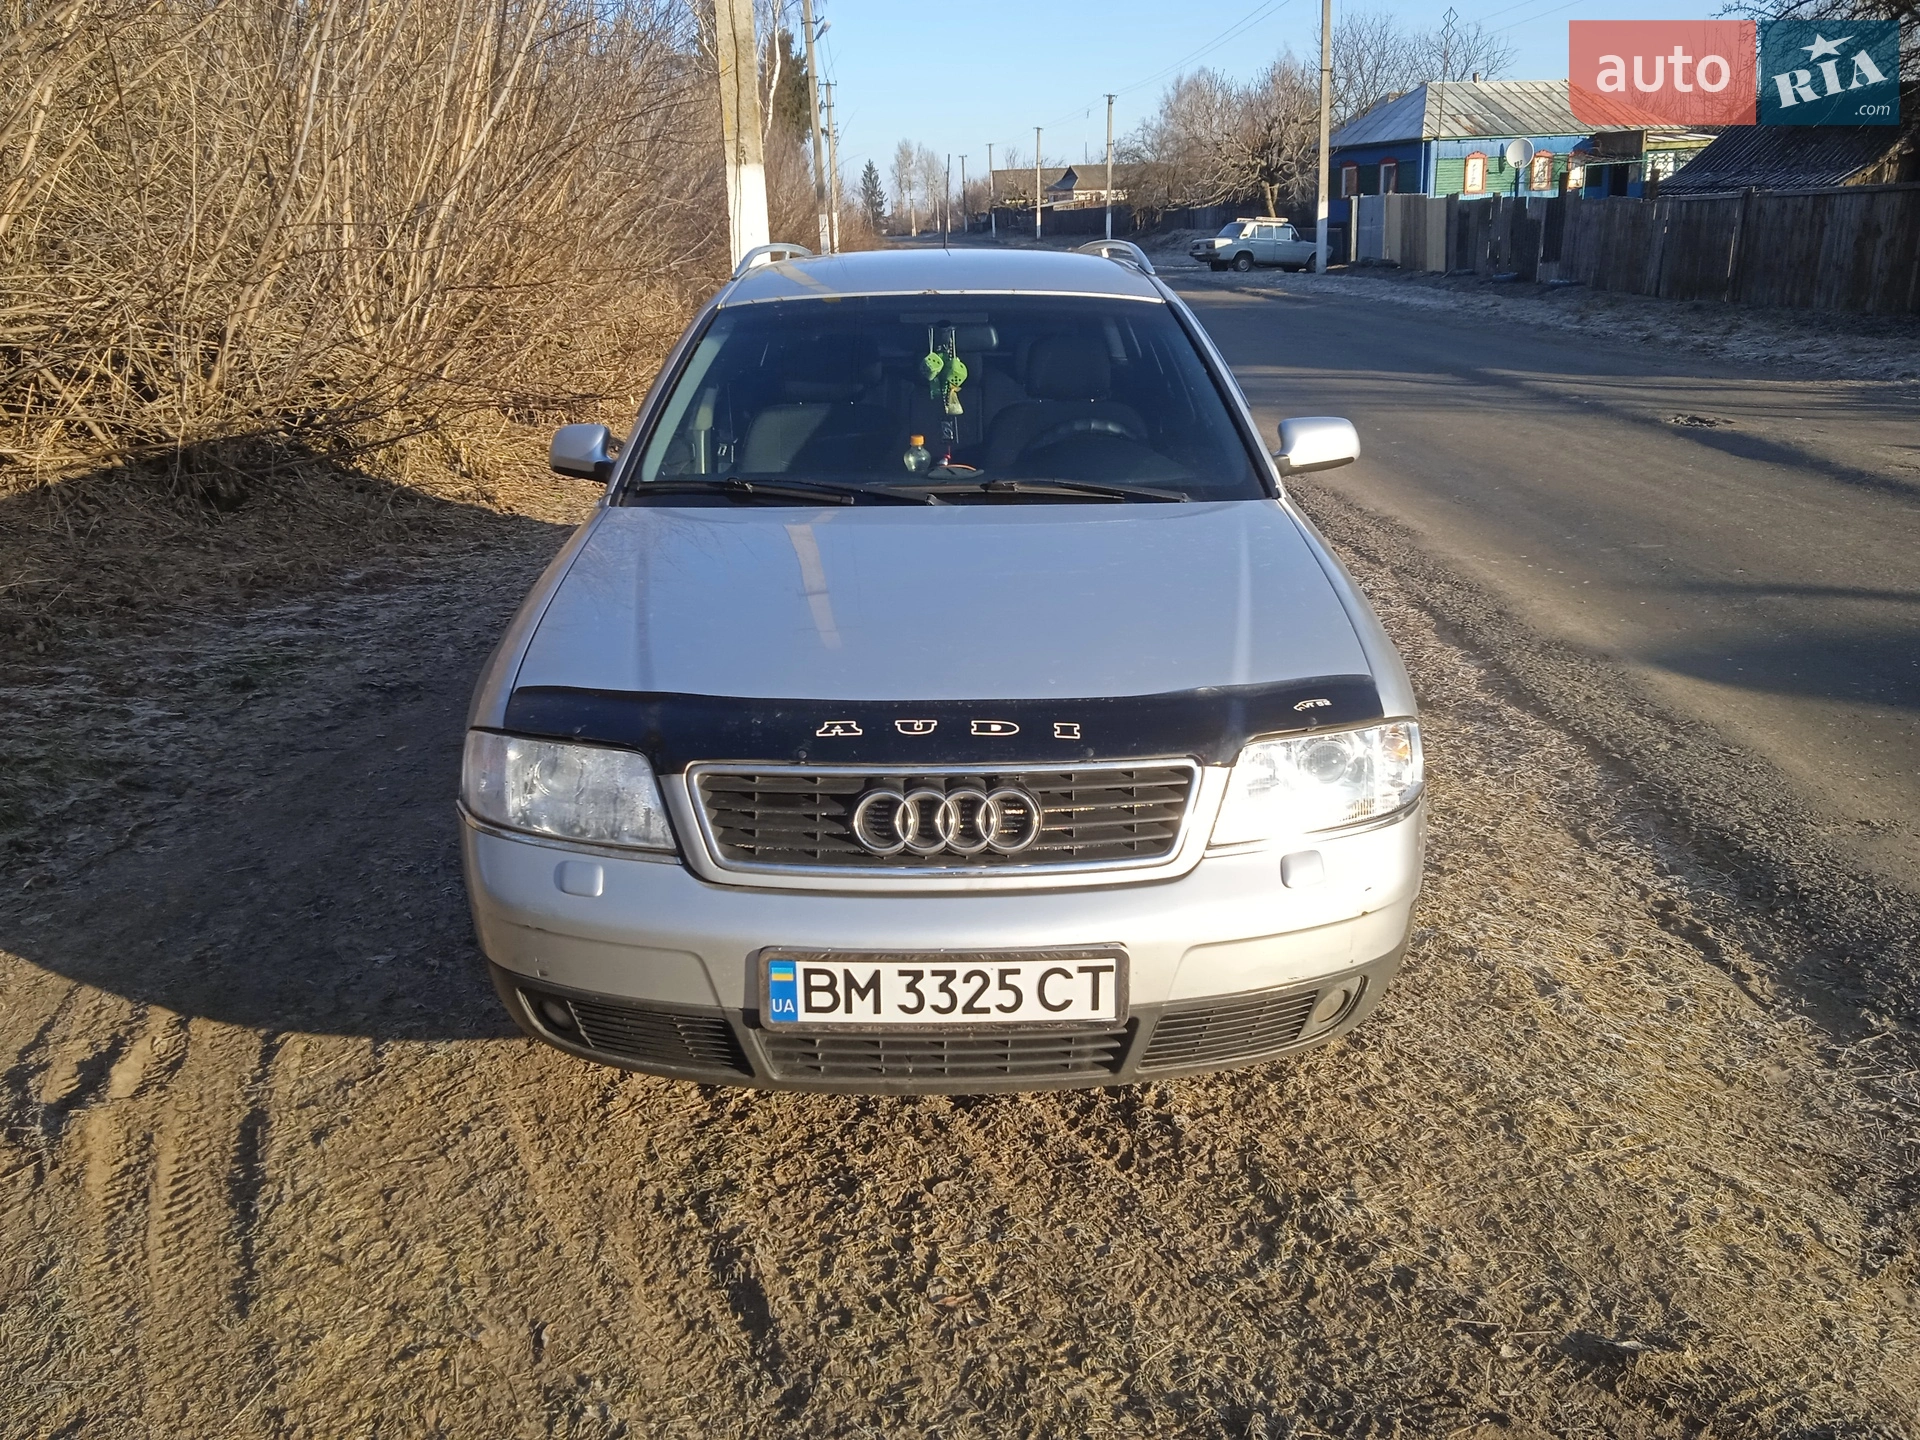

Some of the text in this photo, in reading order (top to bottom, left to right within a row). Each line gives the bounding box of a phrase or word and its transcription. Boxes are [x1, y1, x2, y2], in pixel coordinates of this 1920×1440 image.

[816, 720, 1081, 739] AUDI
[803, 965, 1114, 1015] BM 3325 CT
[772, 998, 796, 1013] UA
